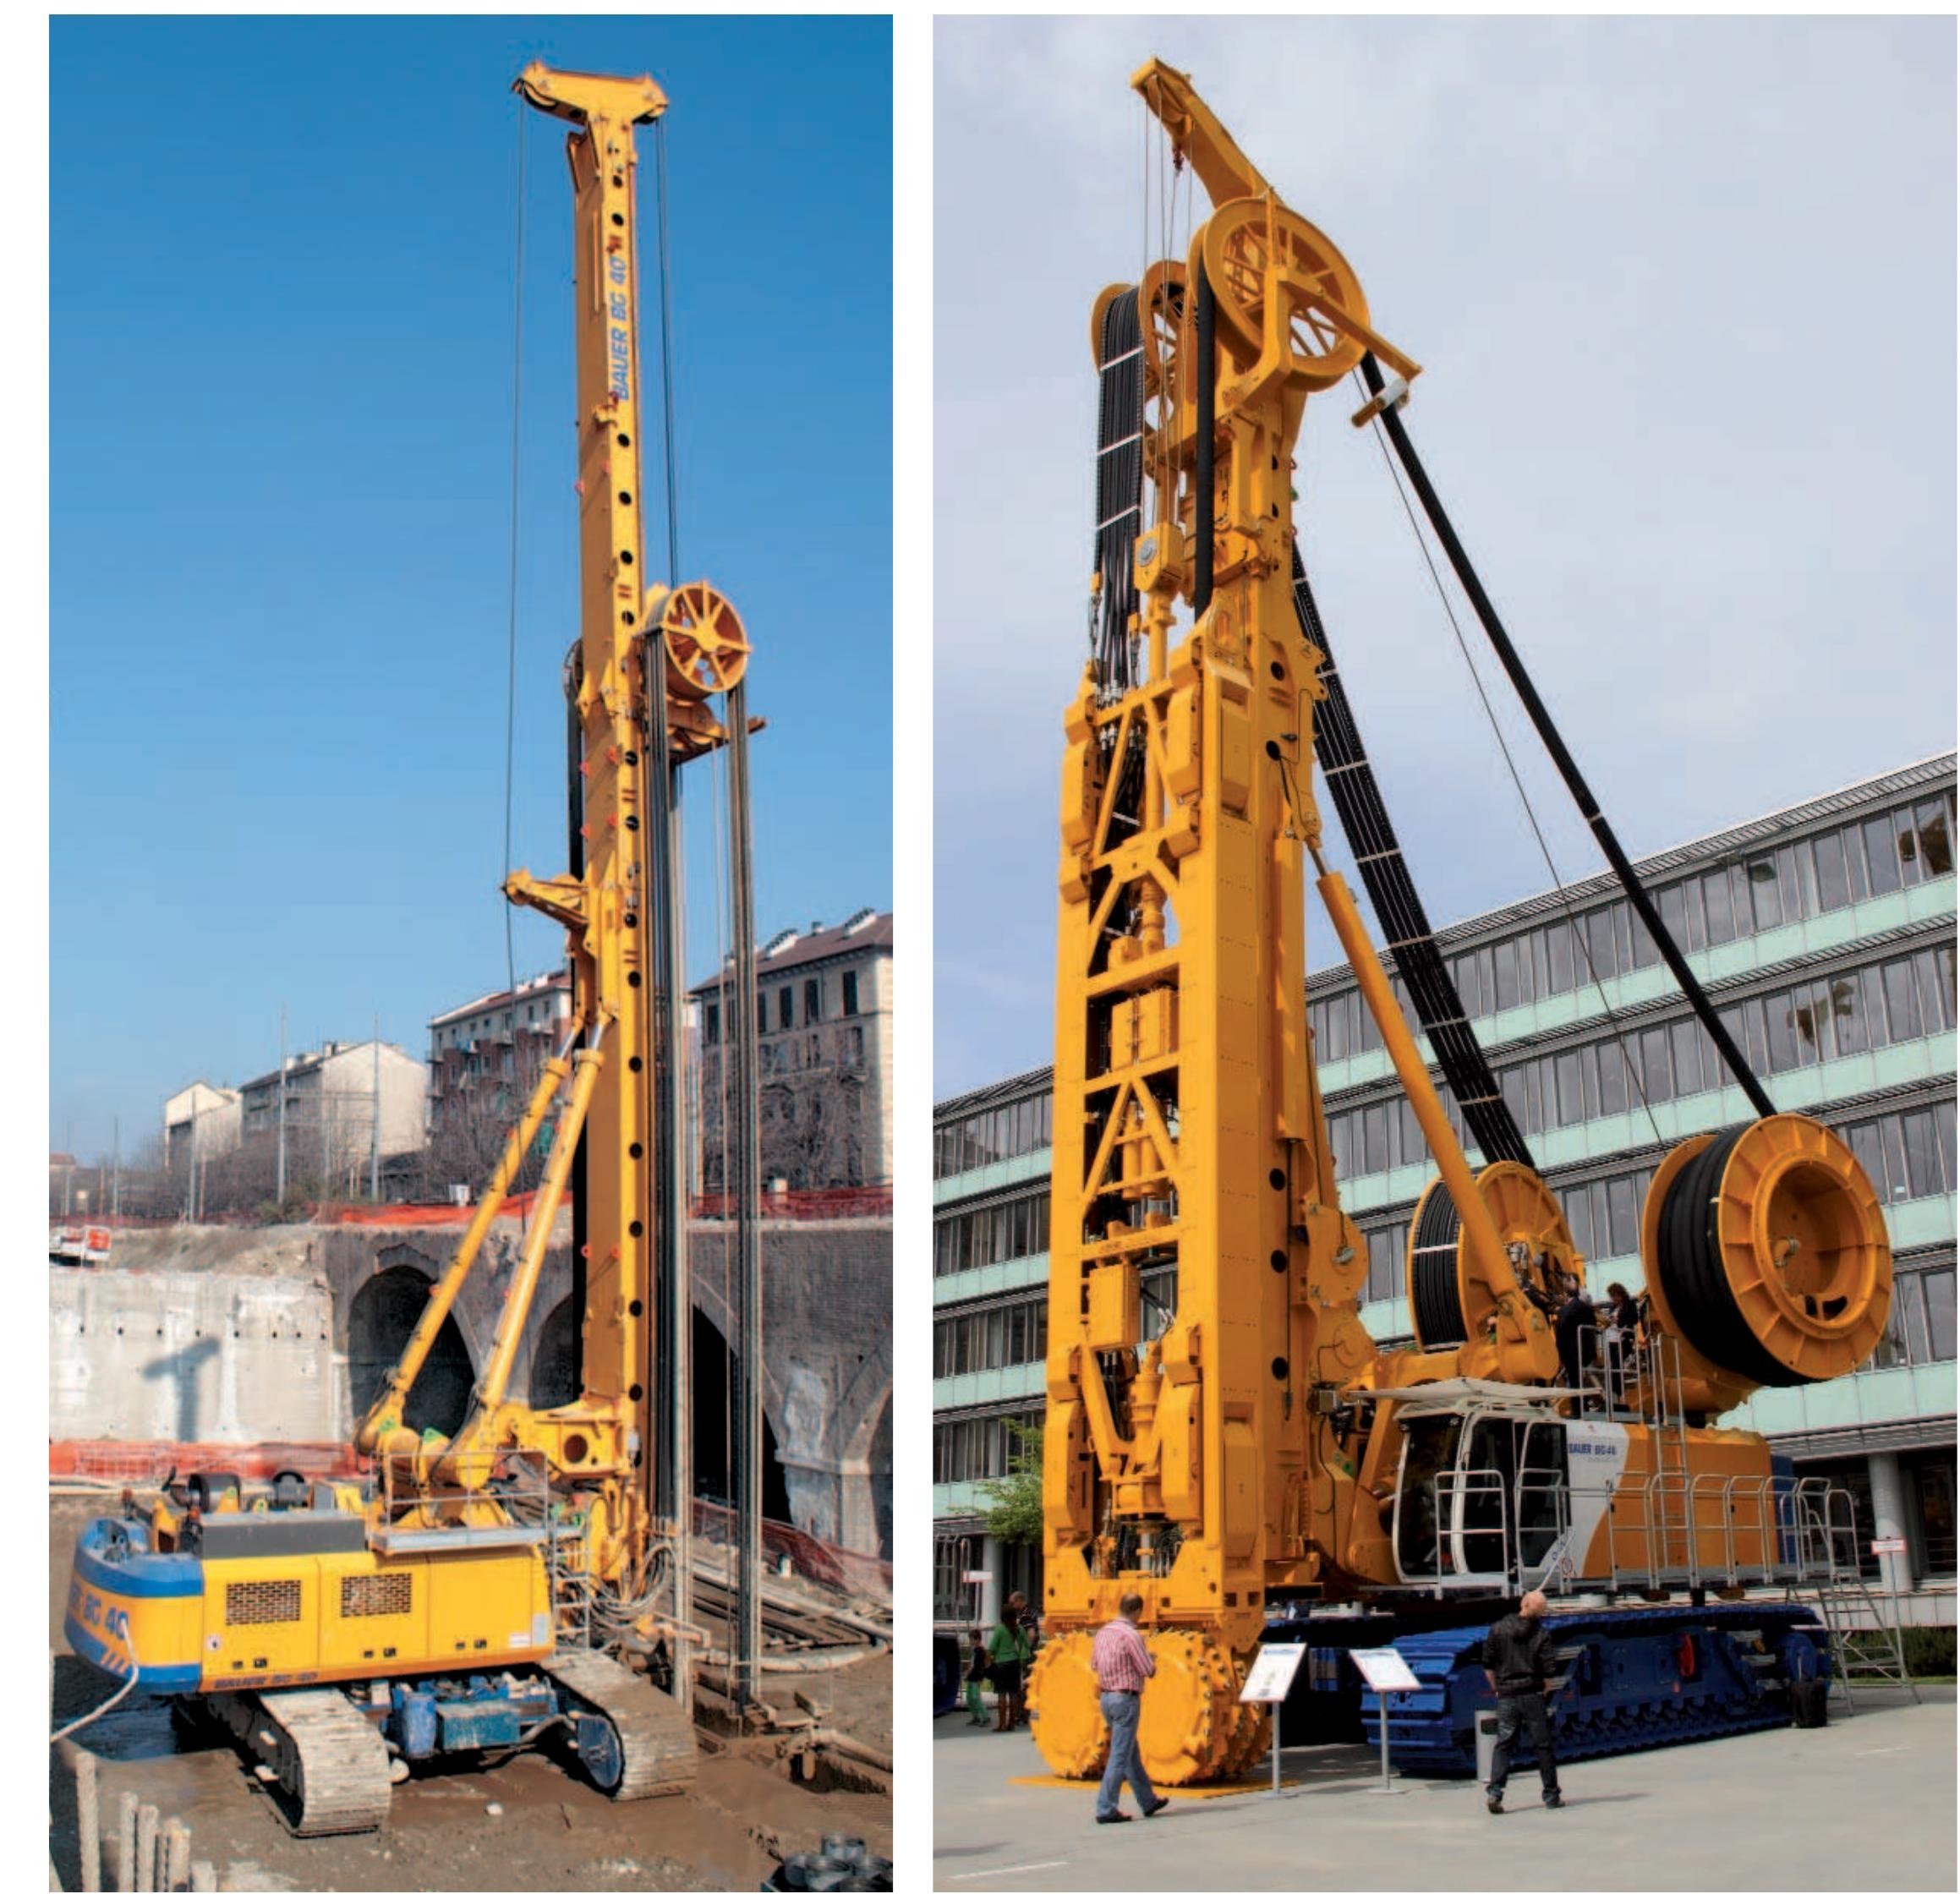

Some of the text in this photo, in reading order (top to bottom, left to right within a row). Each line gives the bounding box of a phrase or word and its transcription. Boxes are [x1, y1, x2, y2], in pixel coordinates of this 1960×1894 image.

[609, 255, 629, 401] BAUER BG 40
[105, 1607, 129, 1640] 40
